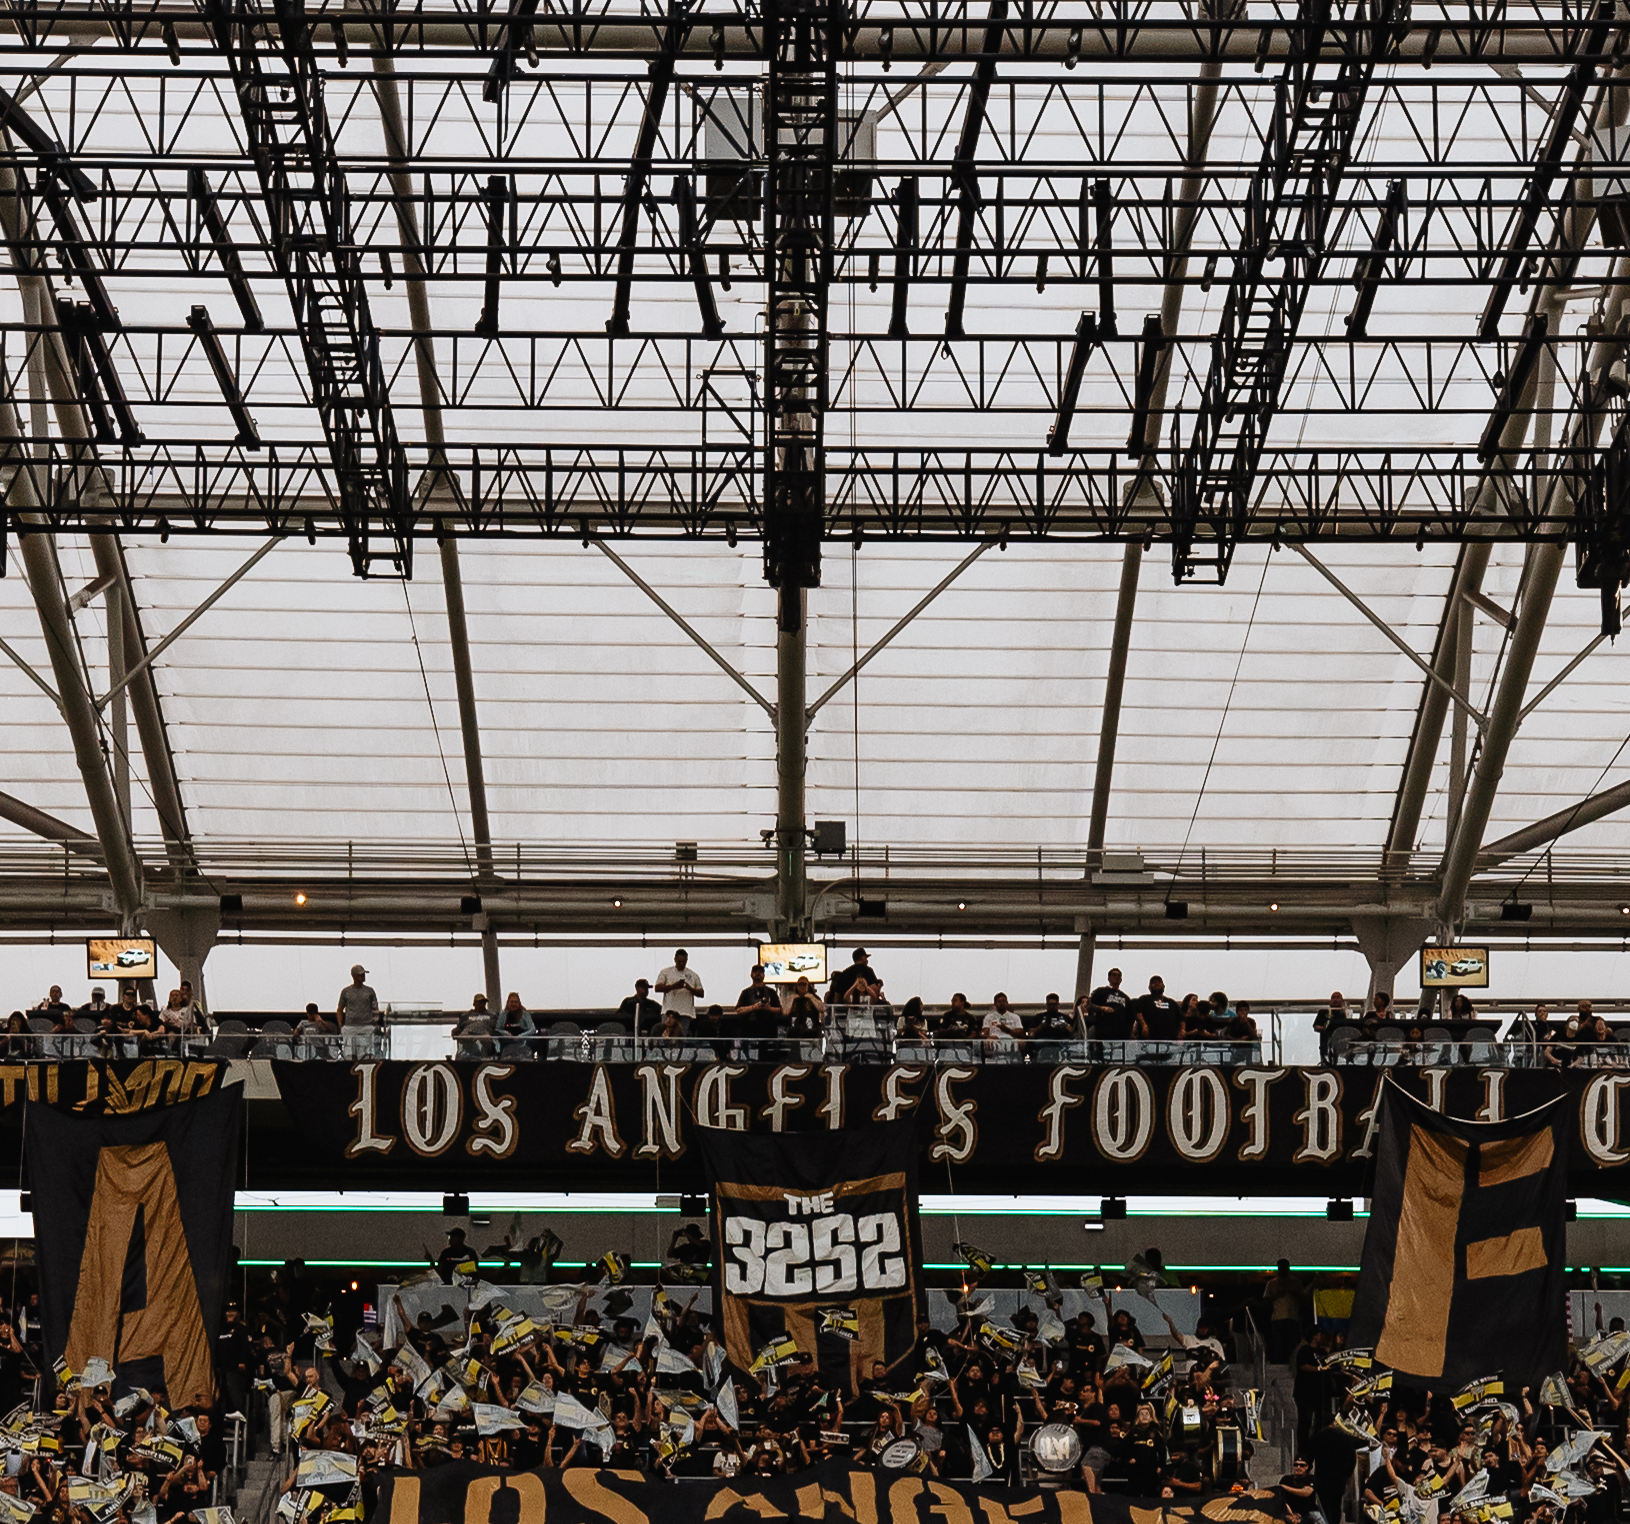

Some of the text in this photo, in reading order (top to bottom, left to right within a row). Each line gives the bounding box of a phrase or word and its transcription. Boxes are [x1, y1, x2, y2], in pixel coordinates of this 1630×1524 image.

[346, 1061, 520, 1158] LOS
[783, 1192, 835, 1215] THE
[725, 1212, 906, 1295] 3252
[1374, 1124, 1555, 1378] F
